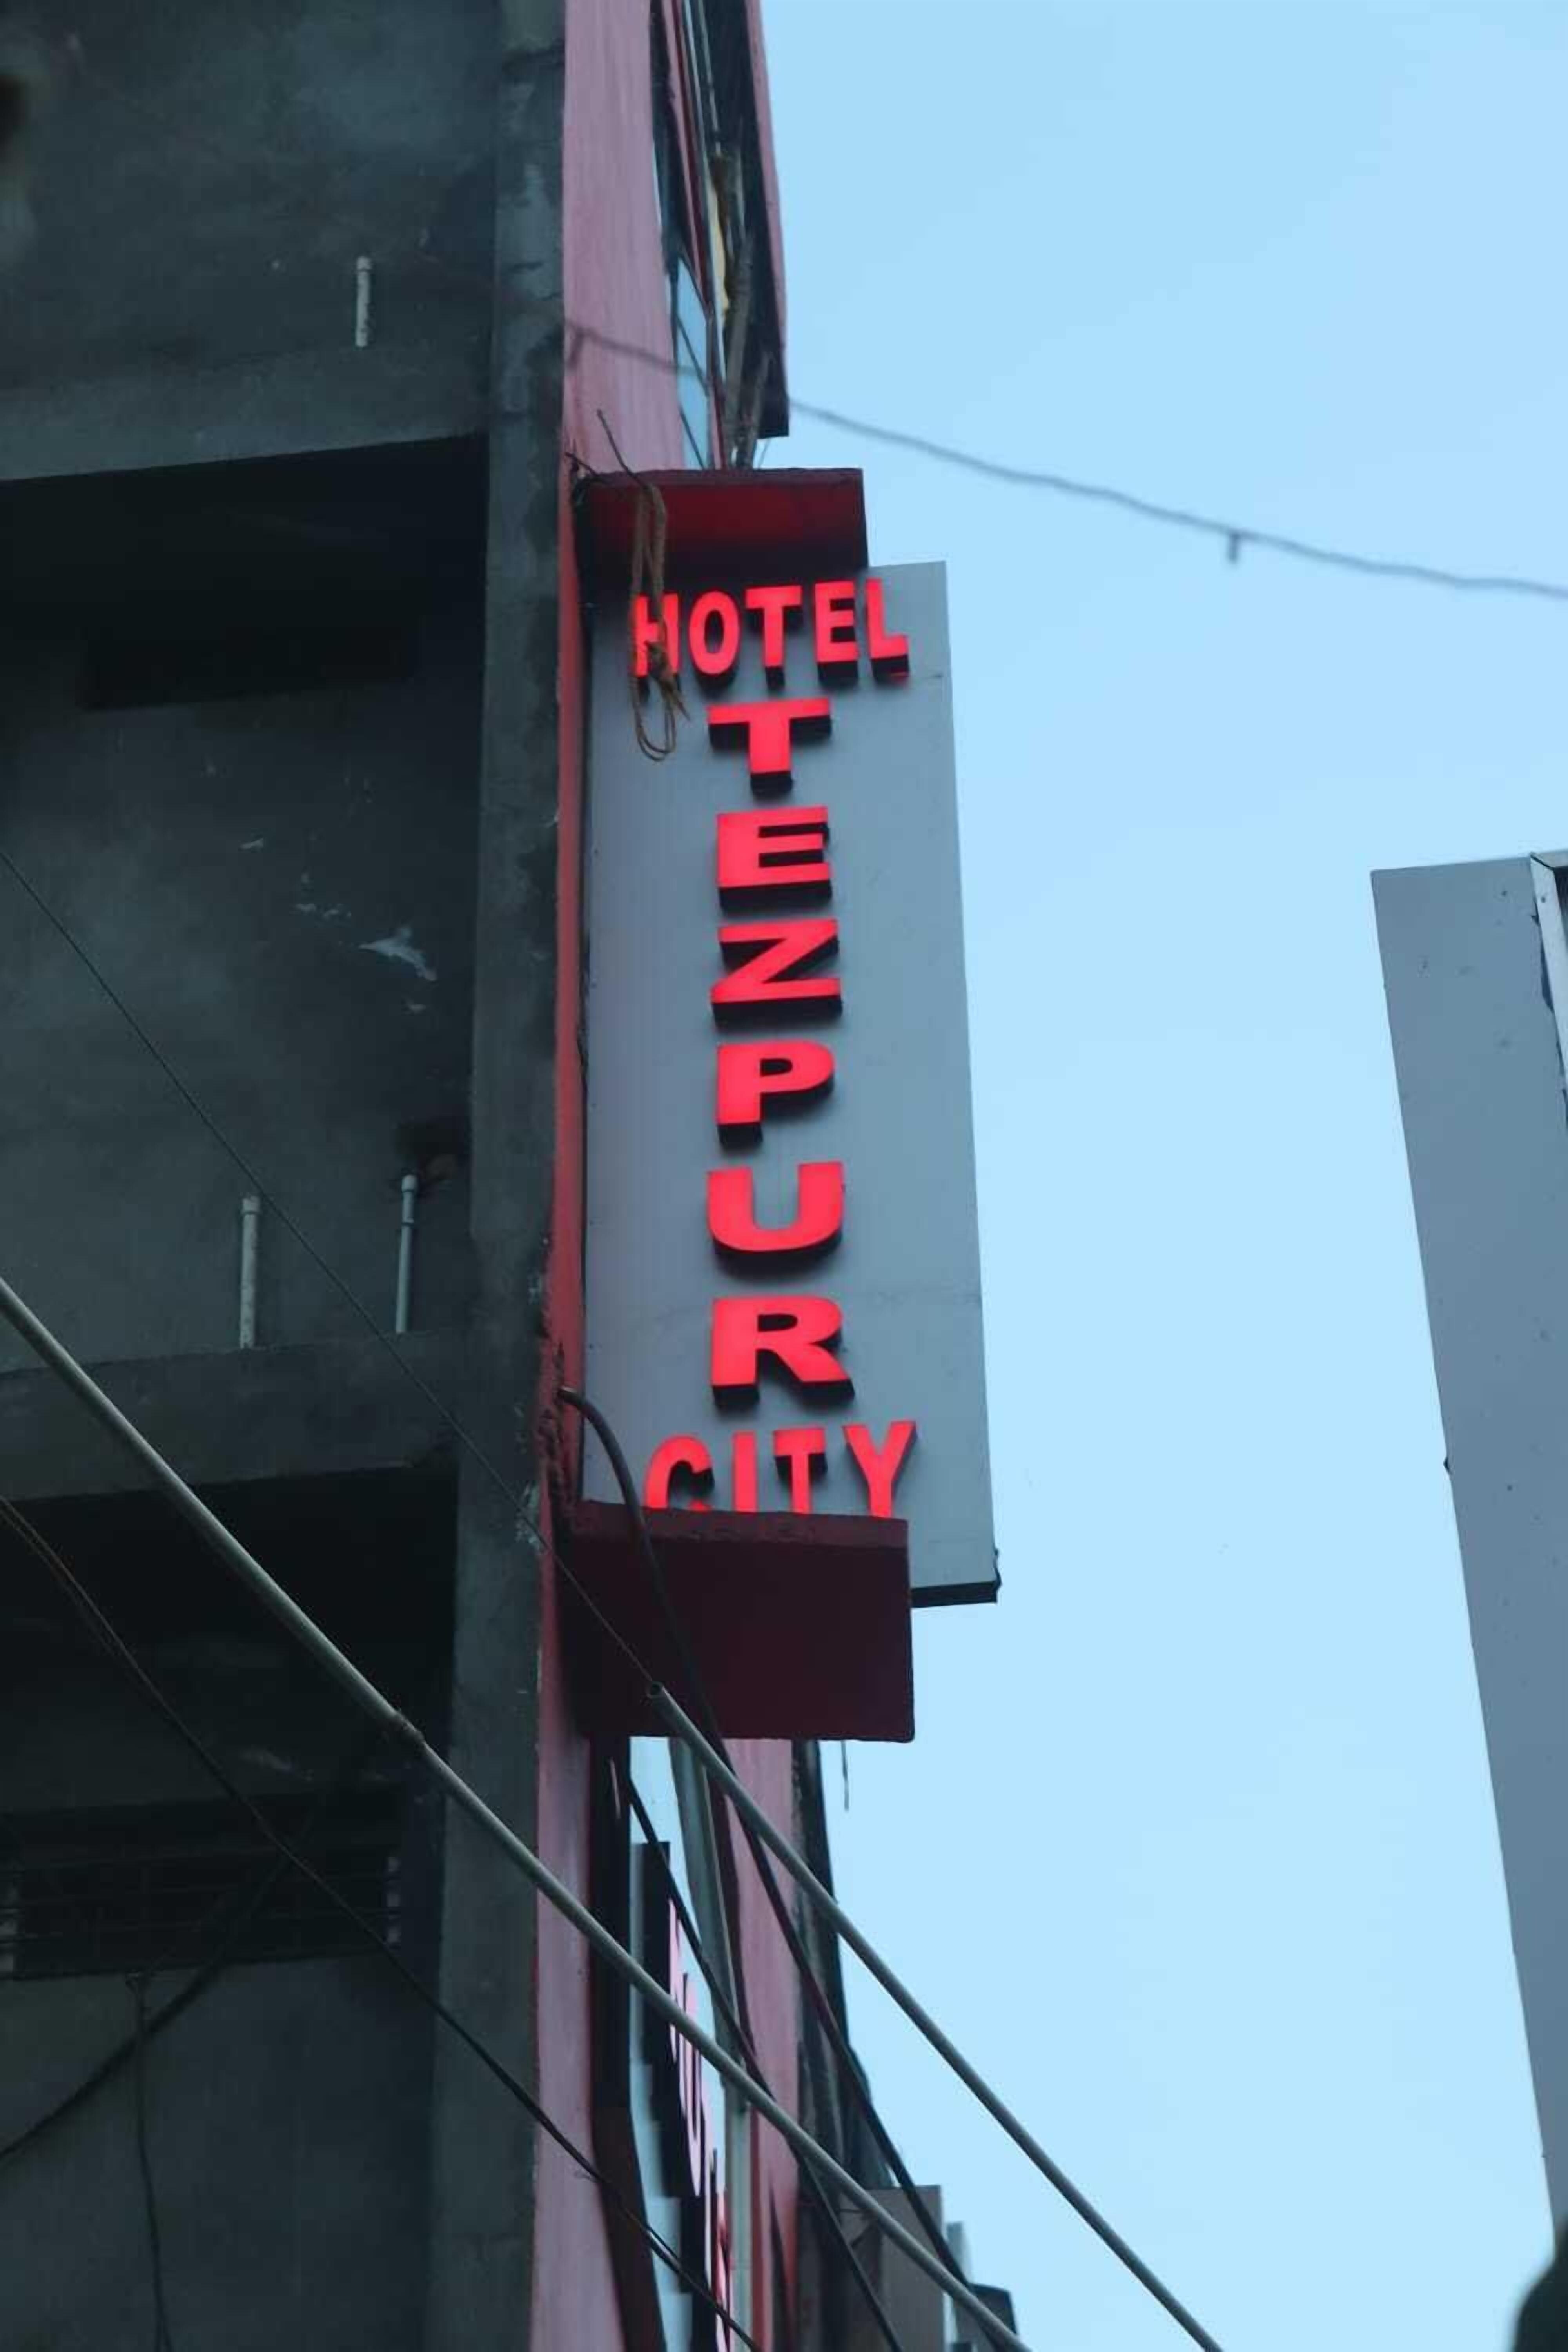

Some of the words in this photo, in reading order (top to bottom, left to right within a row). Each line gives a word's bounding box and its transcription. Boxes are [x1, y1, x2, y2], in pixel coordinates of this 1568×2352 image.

[632, 579, 909, 678] HOTEL
[708, 697, 848, 1390] TEZPUR
[644, 1421, 914, 1518] CITY
